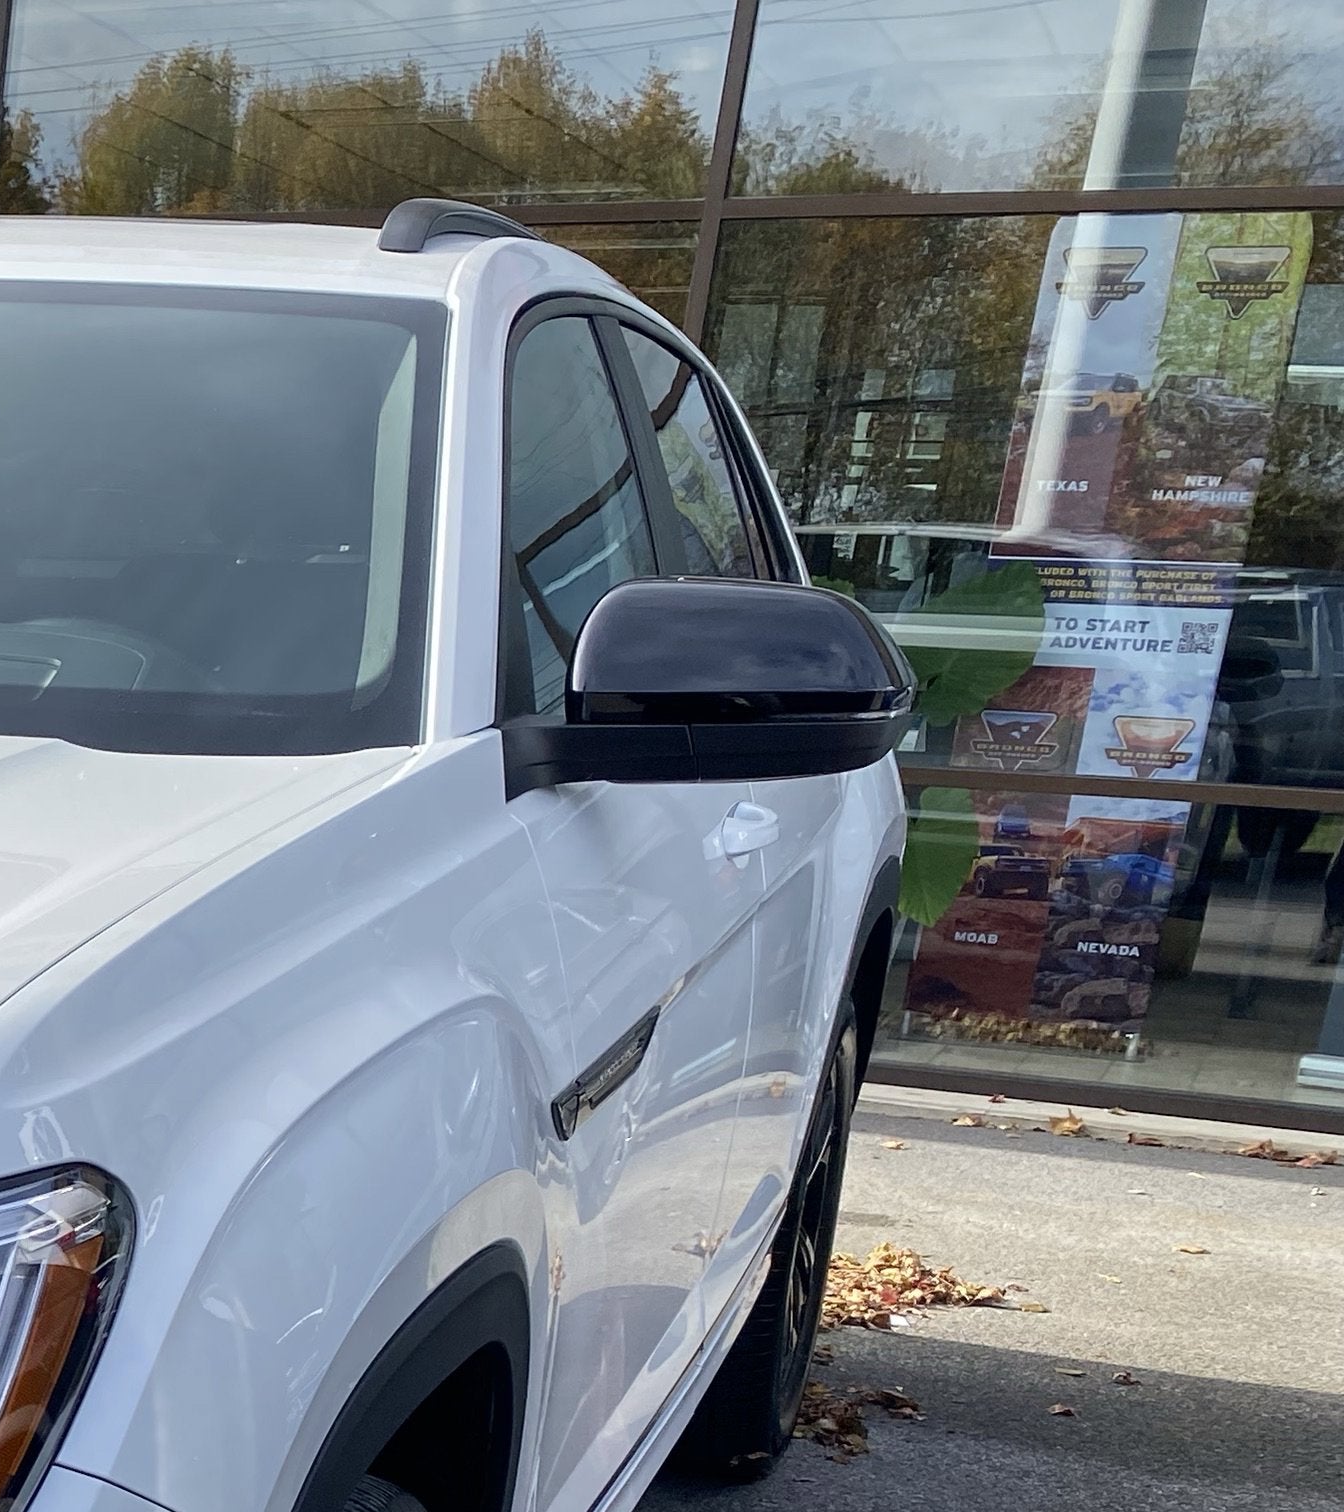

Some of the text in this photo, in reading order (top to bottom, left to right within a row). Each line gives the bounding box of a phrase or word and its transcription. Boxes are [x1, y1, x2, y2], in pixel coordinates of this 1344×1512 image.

[1037, 480, 1089, 492] TEXAS
[1184, 475, 1222, 487] NEW
[1152, 489, 1250, 502] HAMPSHIRE
[1111, 569, 1133, 577] THE
[1136, 570, 1199, 580] PURCHASE
[1091, 580, 1138, 589] BRONCO
[1068, 590, 1115, 599] BRONCO
[1119, 592, 1157, 601] SPORT
[1054, 617, 1150, 633] TO START
[1049, 636, 1173, 653] ADVENTURE
[977, 743, 1050, 753] BRONCO
[1109, 751, 1186, 761] BRONCO
[954, 931, 999, 945] MOAB
[1077, 942, 1140, 957] NEVADA
